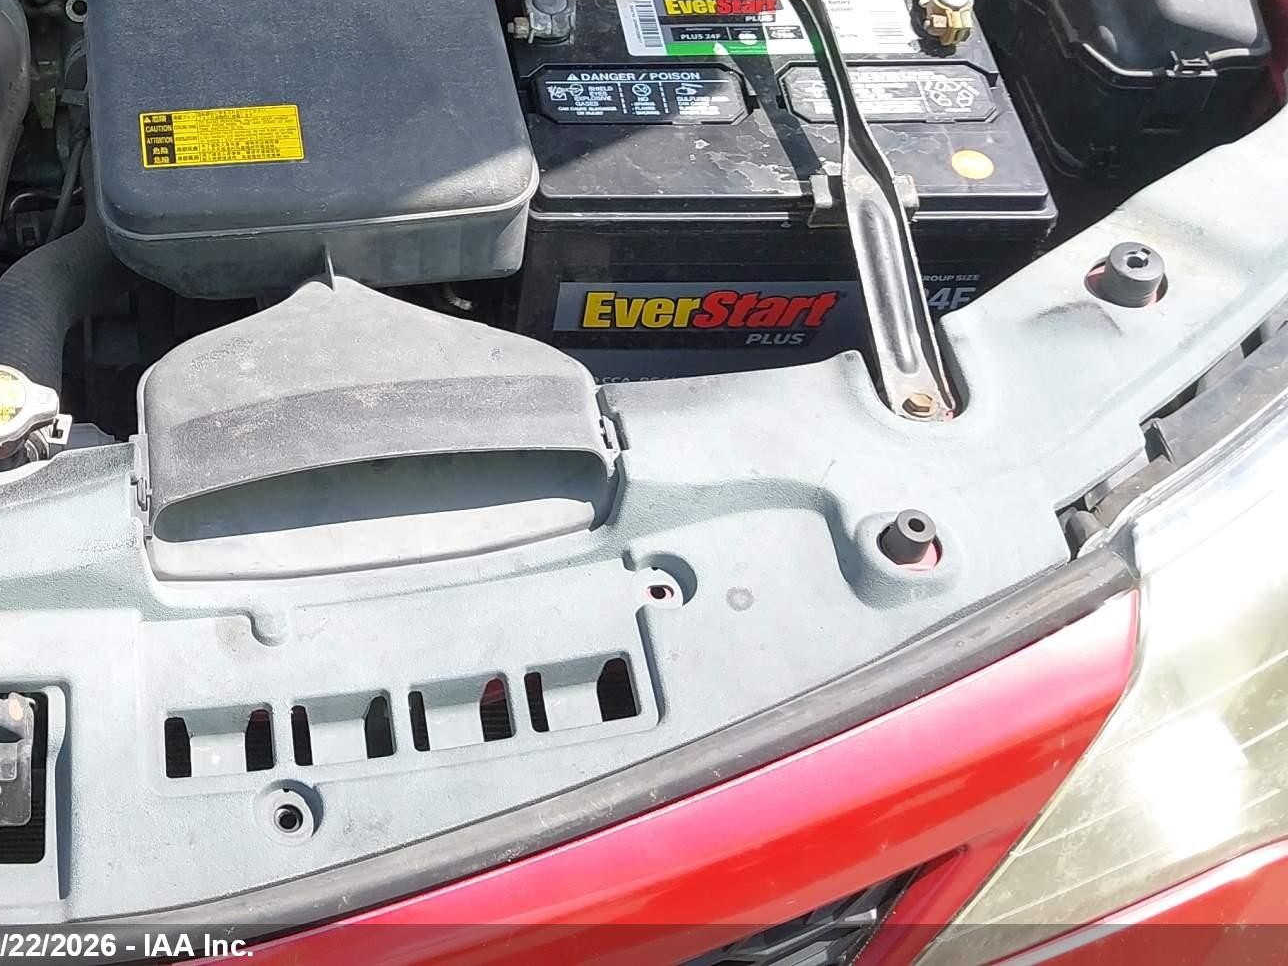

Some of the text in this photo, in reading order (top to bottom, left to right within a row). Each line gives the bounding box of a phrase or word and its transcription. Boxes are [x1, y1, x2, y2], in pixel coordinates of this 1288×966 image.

[580, 73, 636, 81] DANGER
[649, 72, 701, 80] POISON
[145, 125, 173, 133] CAUTION
[147, 136, 174, 144] ATTENTION
[582, 291, 841, 328] EverStart
[745, 333, 807, 346] PLUS
